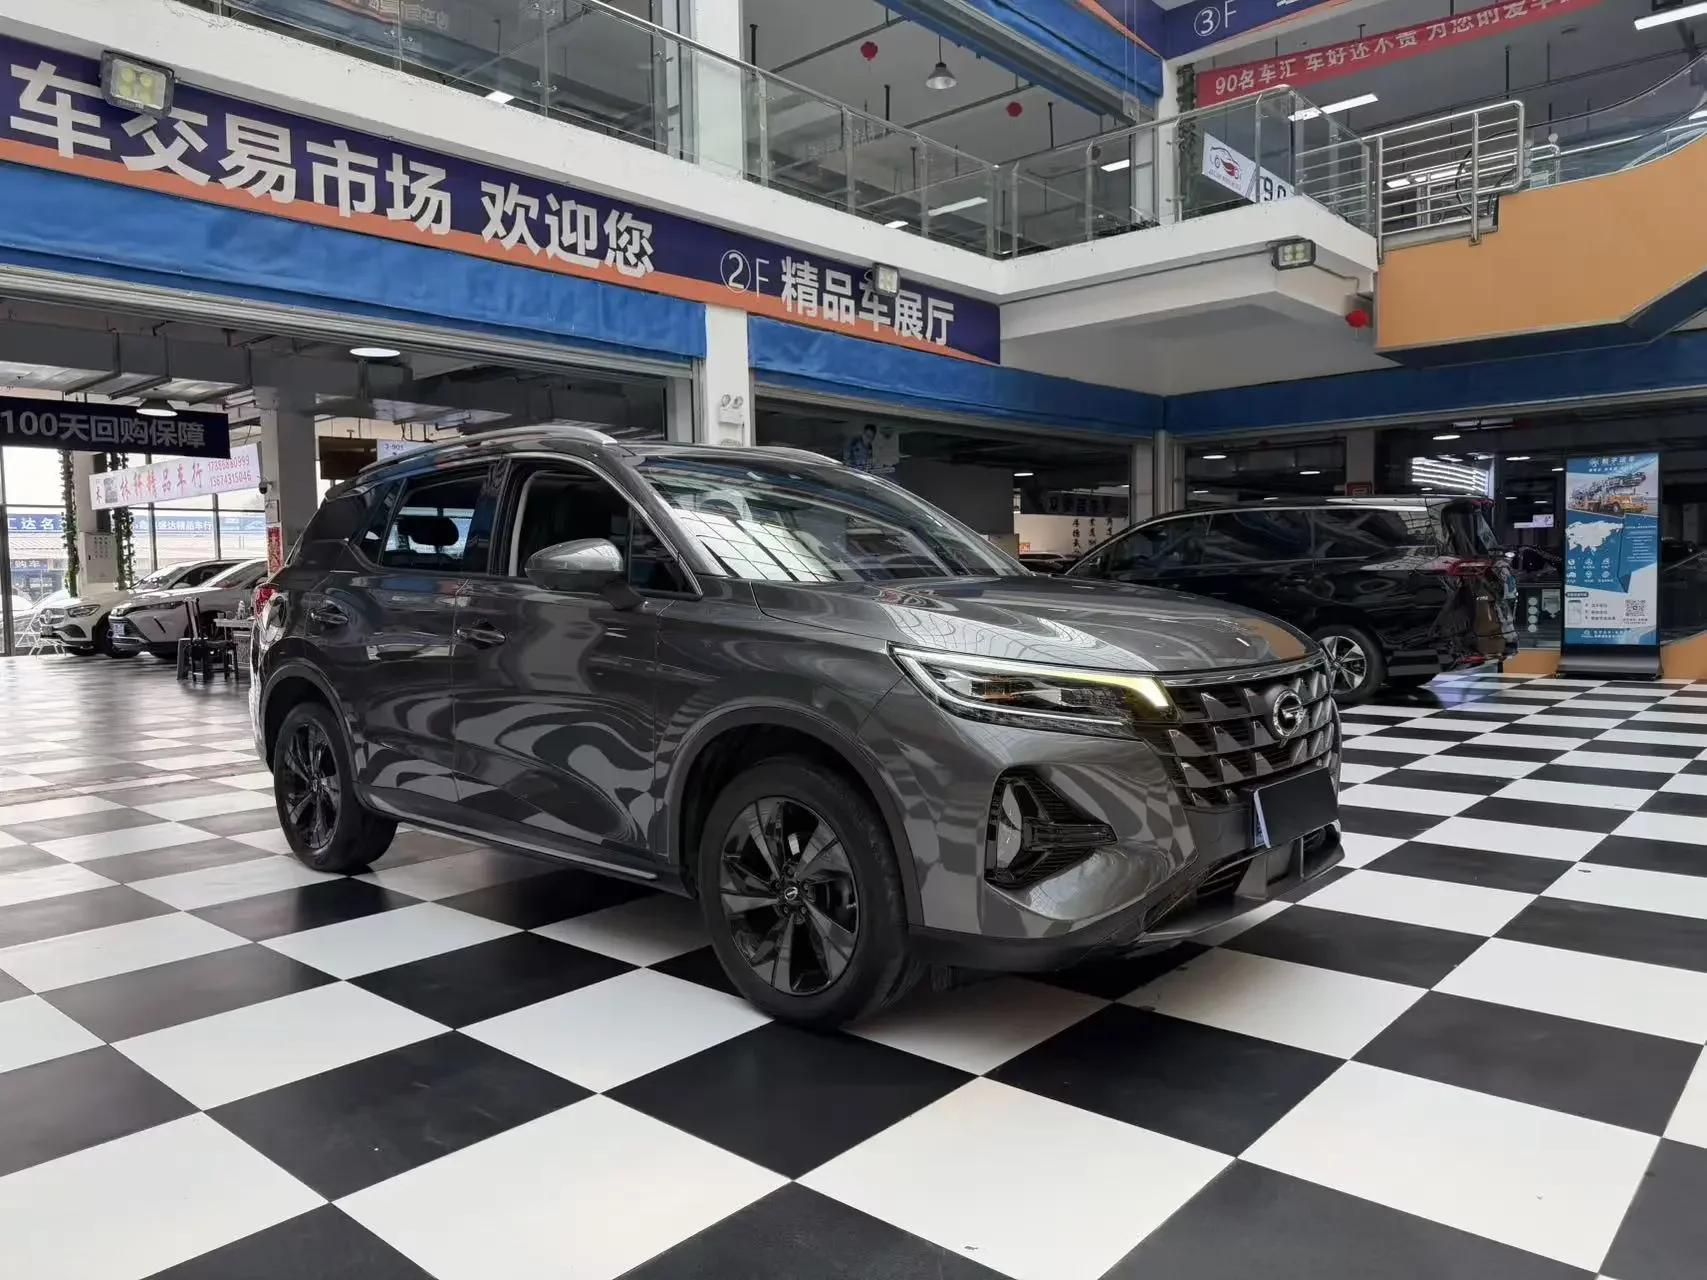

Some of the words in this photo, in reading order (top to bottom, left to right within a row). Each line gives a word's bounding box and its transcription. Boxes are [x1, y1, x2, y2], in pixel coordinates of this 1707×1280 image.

[10, 60, 452, 235] 车交易市场
[481, 181, 655, 279] 欢迎您
[780, 255, 955, 346] 精品车展厅
[1, 410, 206, 449] 100天回购保障
